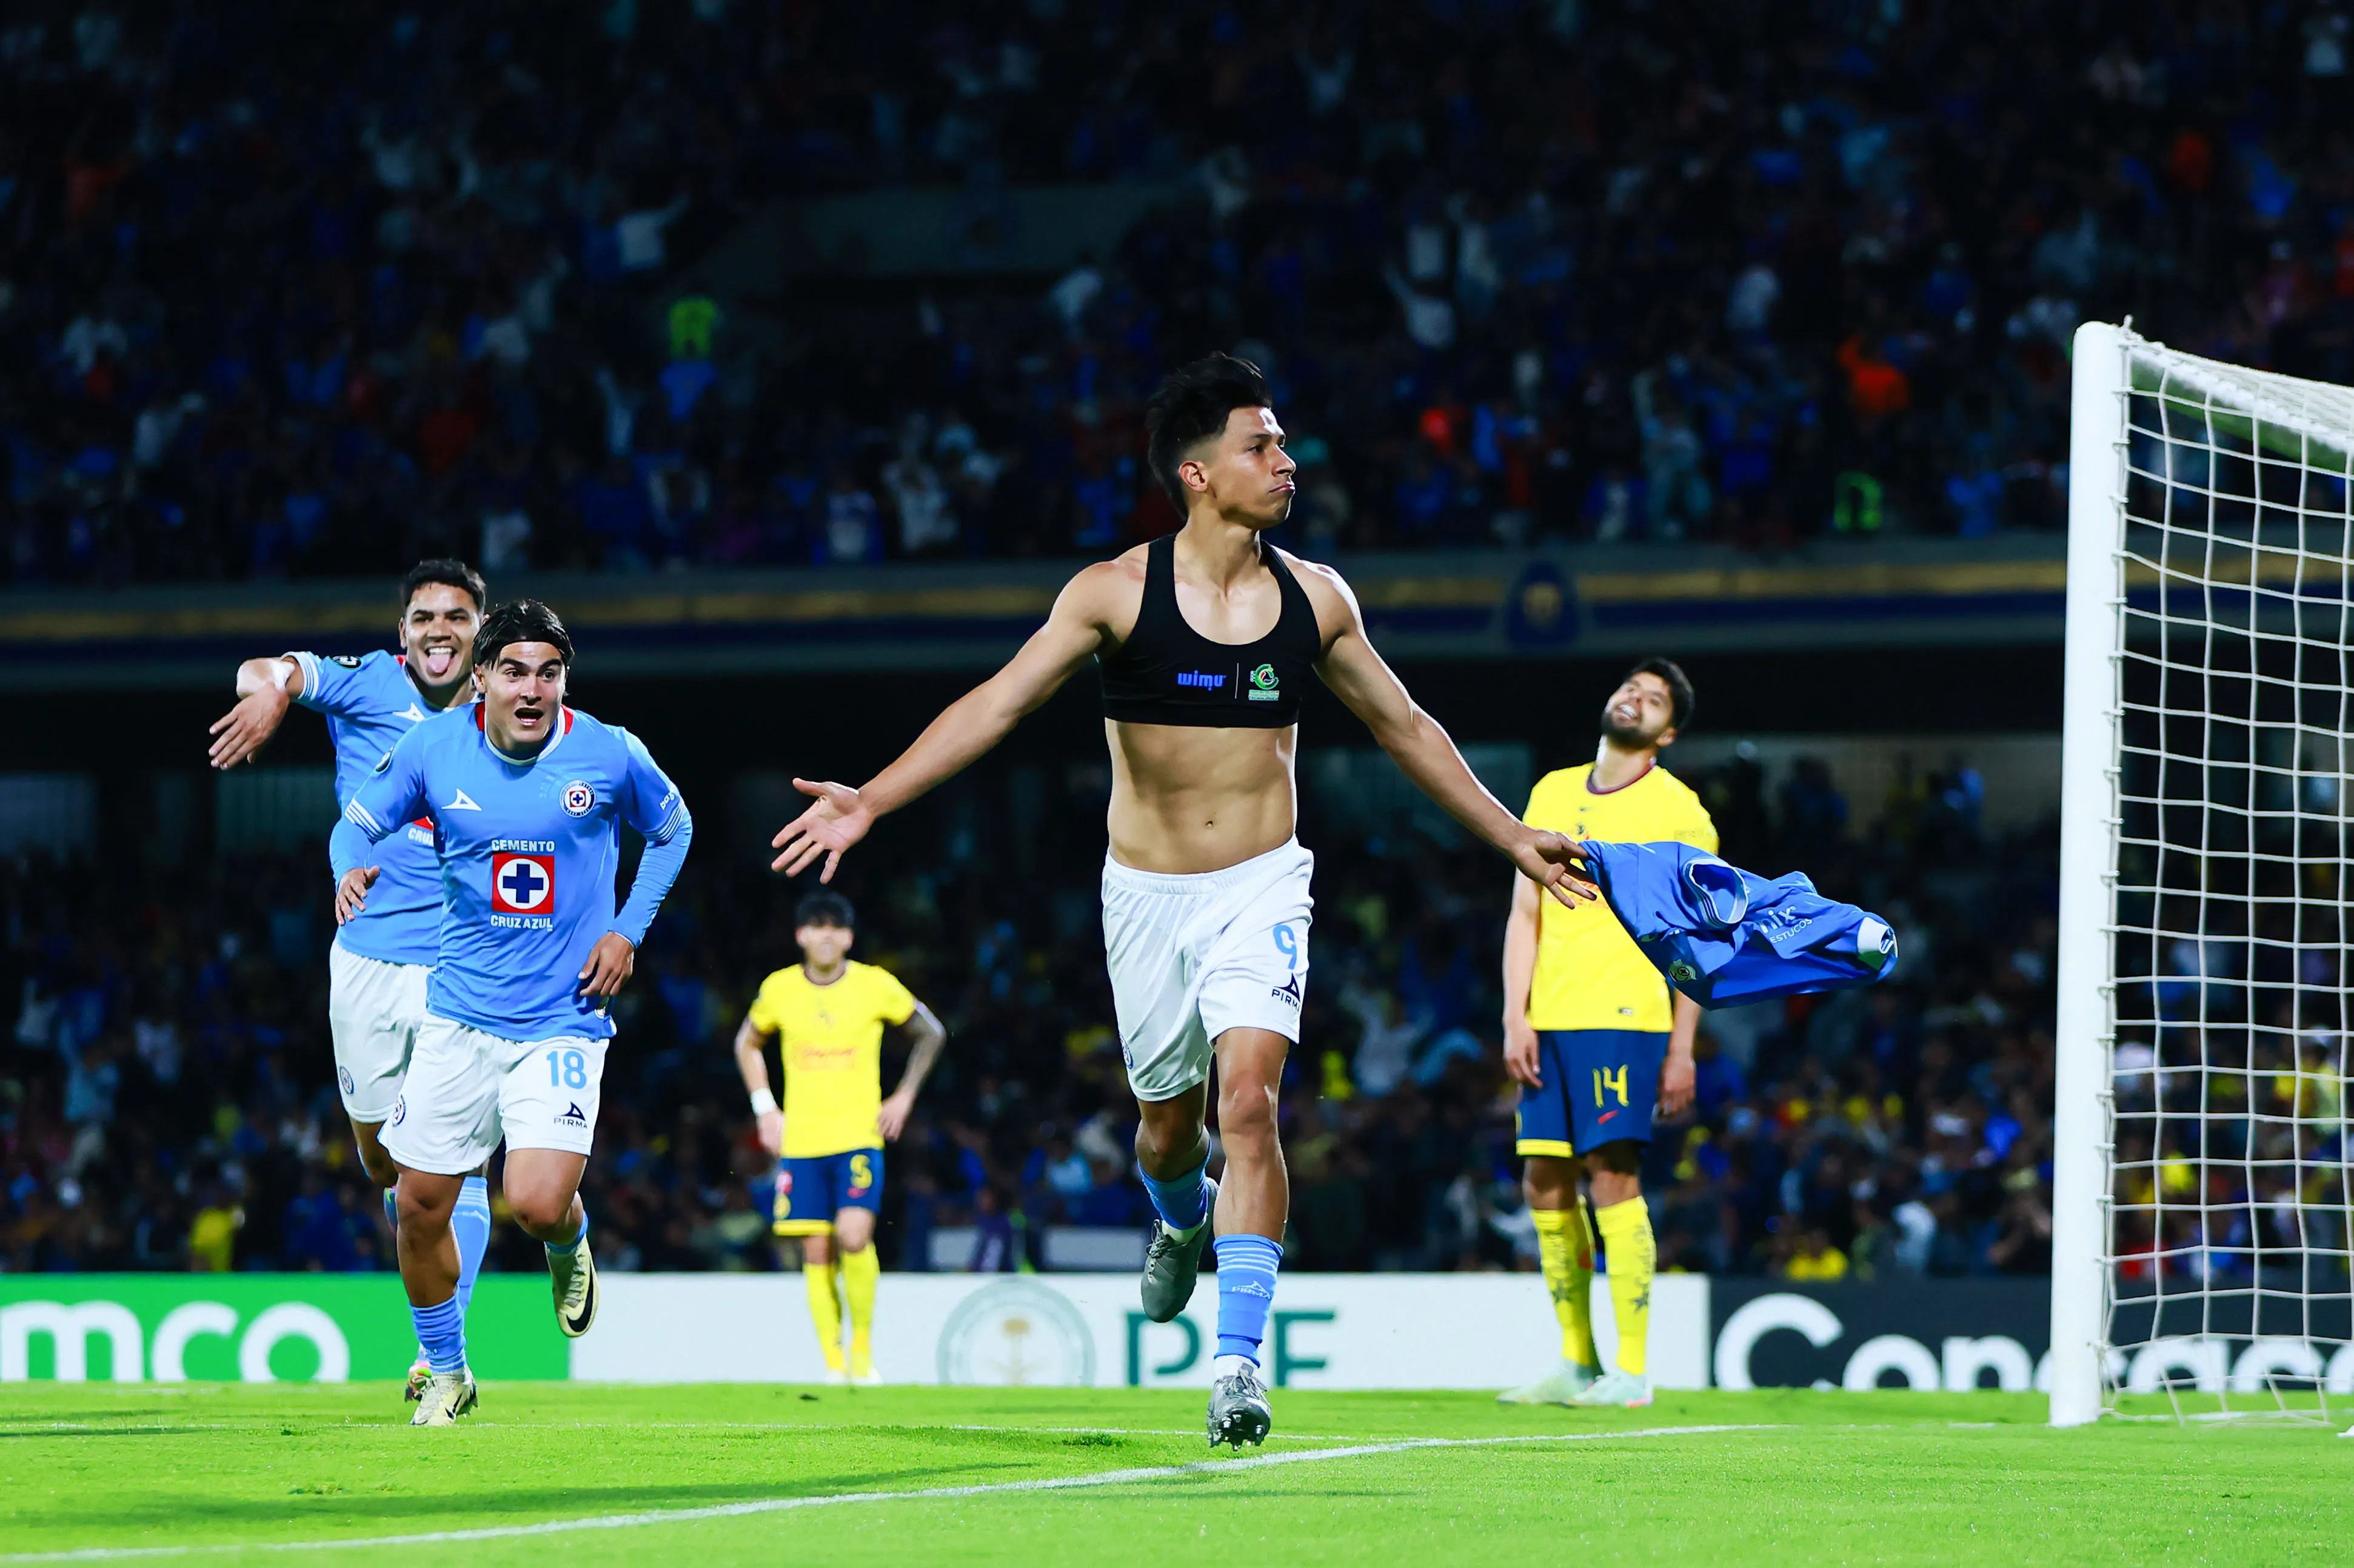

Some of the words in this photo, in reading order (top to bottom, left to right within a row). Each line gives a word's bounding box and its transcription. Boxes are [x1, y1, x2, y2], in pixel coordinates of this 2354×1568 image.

[1178, 670, 1224, 691] wimu
[491, 839, 555, 852] CEMENTO
[490, 914, 521, 929] CRUZ
[522, 917, 553, 930] AZUL
[1769, 918, 1813, 944] ESTUCOS
[1273, 924, 1297, 970] 9
[546, 1050, 587, 1090] 18
[1592, 1064, 1630, 1107] 14
[553, 1117, 587, 1129] PIRMA
[850, 1154, 873, 1189] 5
[1125, 1310, 1336, 1387] PF
